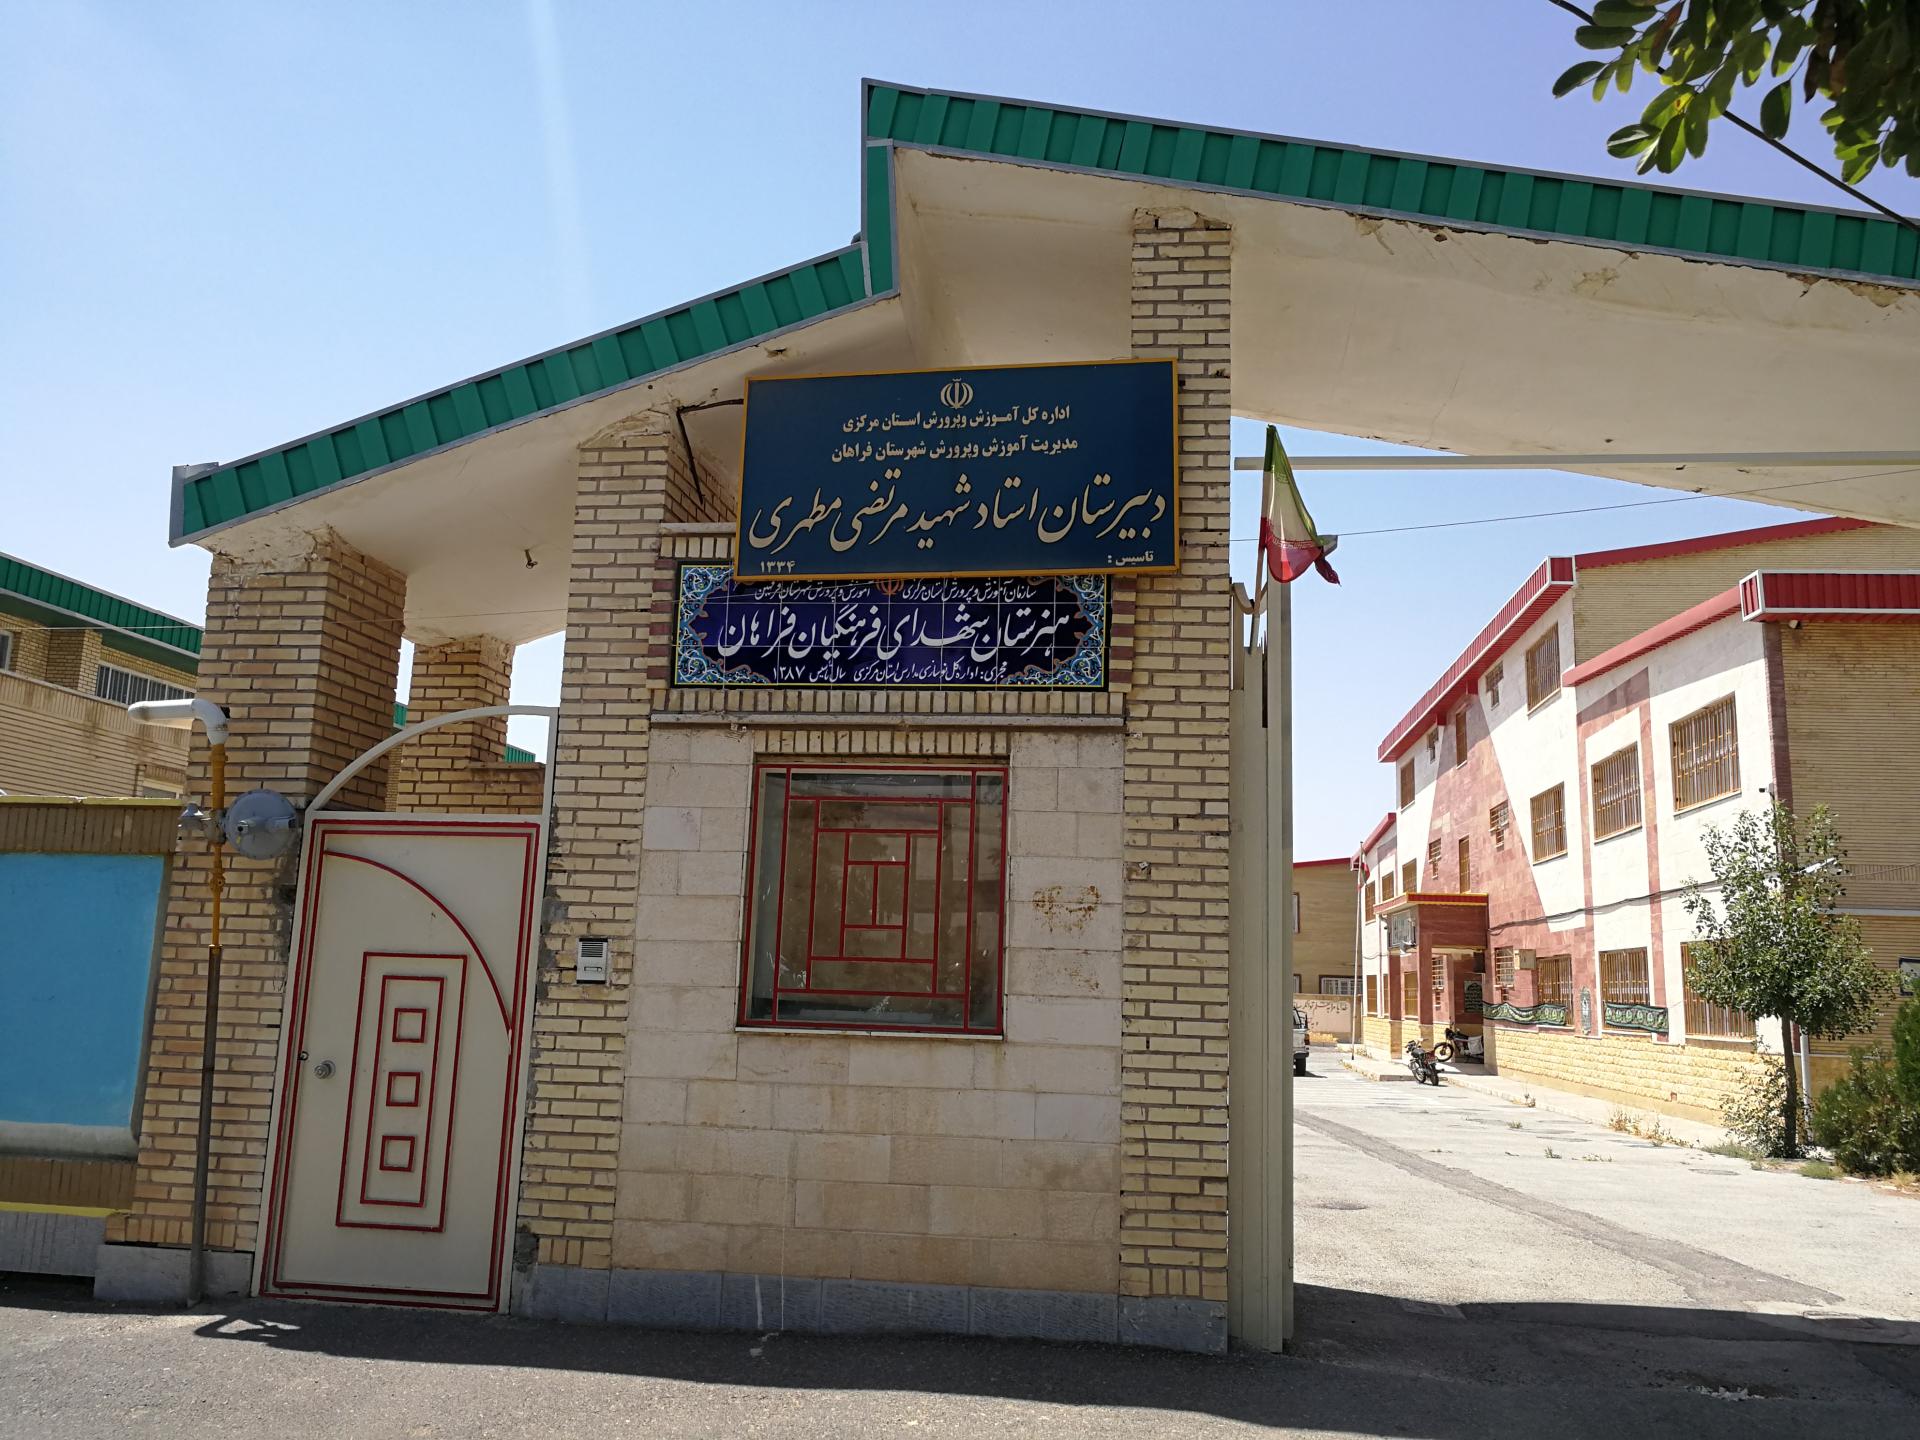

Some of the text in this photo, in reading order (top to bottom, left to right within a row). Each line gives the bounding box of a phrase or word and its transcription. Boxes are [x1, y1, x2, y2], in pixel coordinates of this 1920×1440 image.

[842, 414, 879, 433] مرکزی
[882, 411, 920, 431] استان
[970, 406, 1019, 428] آموزش
[1022, 406, 1039, 425] کل
[1041, 404, 1070, 425] اداره
[831, 441, 872, 463] فراهان
[875, 440, 926, 461] شهرستان
[981, 434, 1028, 458] آموزش
[1030, 436, 1078, 455] مدیریت
[748, 467, 1166, 556] دبیرستان استاد شهید مرتضی مطهری
[760, 560, 796, 574] ۱۳۳۴
[1004, 584, 1037, 603] سازمان
[717, 603, 1070, 663] هنرستان شهدای فرهنگیان فراهان
[773, 665, 806, 681] ۱۳۸۷
[829, 665, 847, 683] سال
[853, 659, 880, 682] مرکزی
